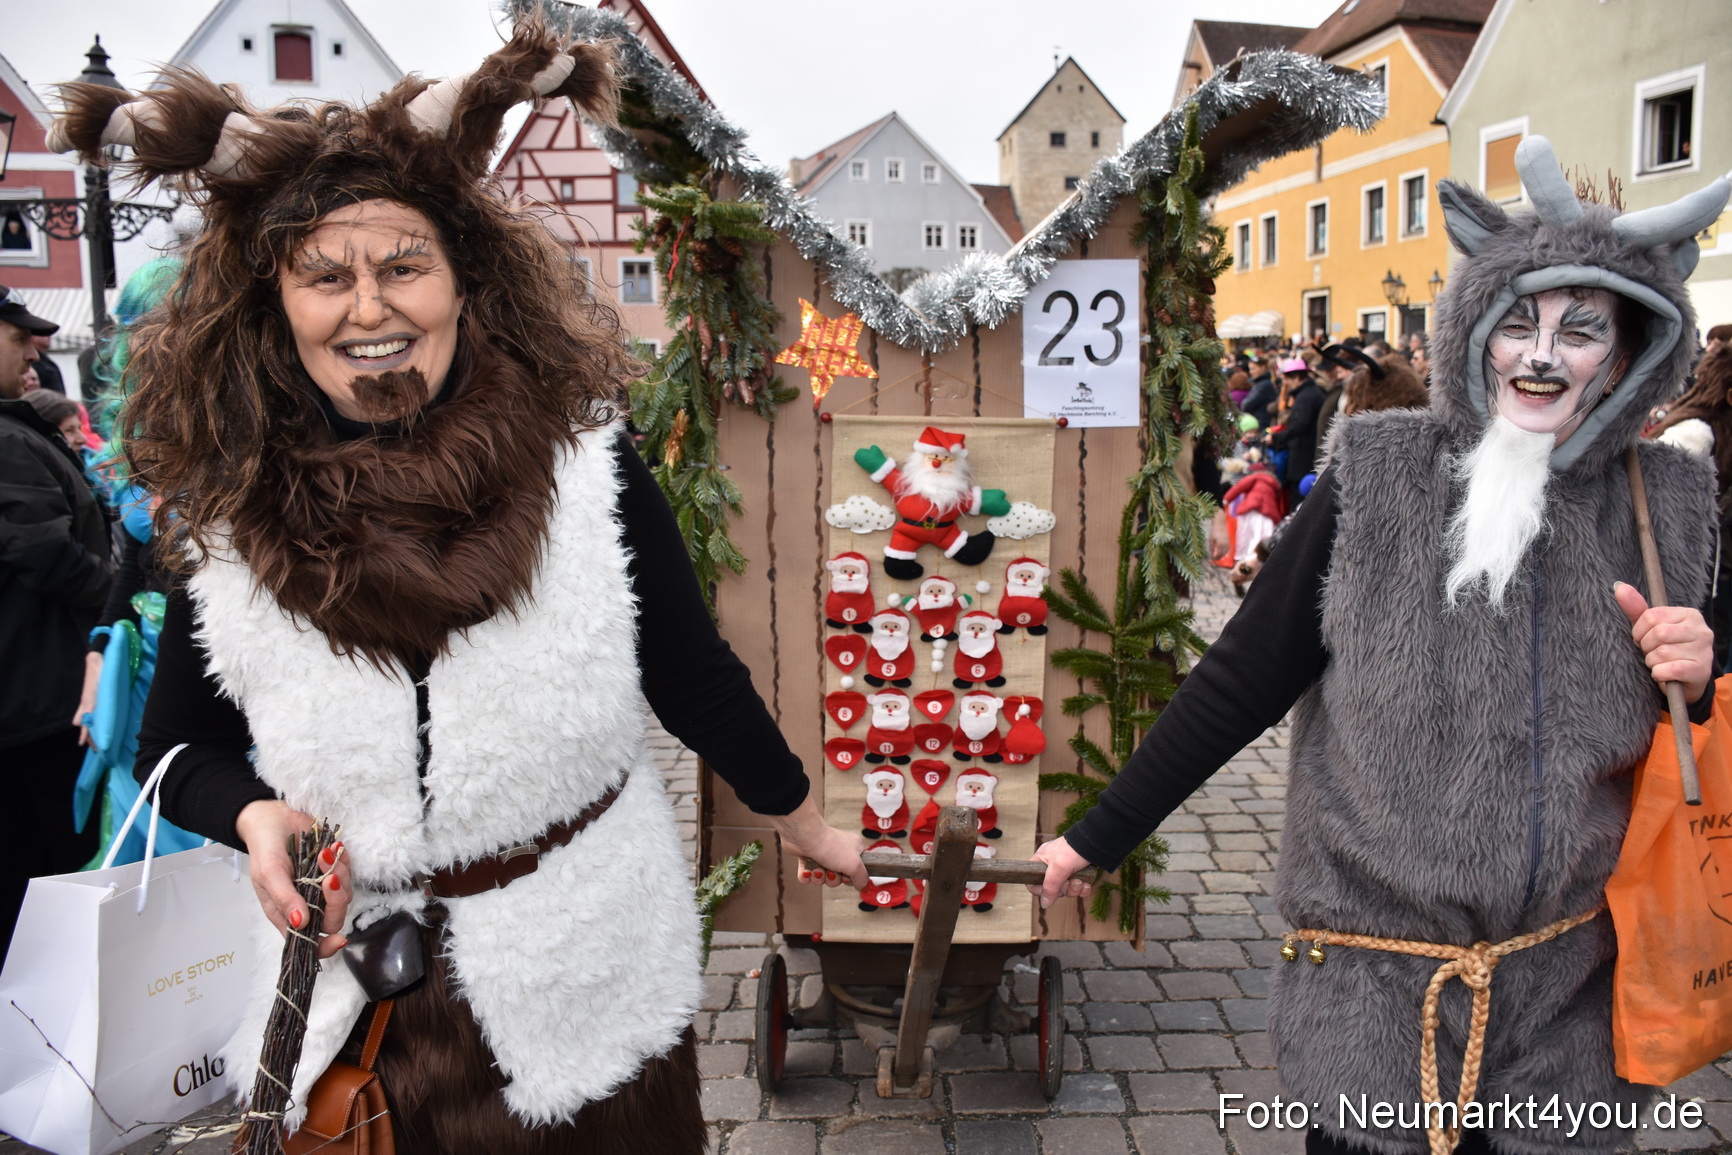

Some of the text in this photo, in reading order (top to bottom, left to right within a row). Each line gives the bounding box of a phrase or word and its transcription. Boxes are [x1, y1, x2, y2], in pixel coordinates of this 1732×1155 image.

[1038, 290, 1125, 366] 23
[928, 740, 937, 749] 12
[971, 742, 981, 751] 13
[148, 951, 235, 996] LOVE STORY
[173, 1052, 225, 1097] Chlo
